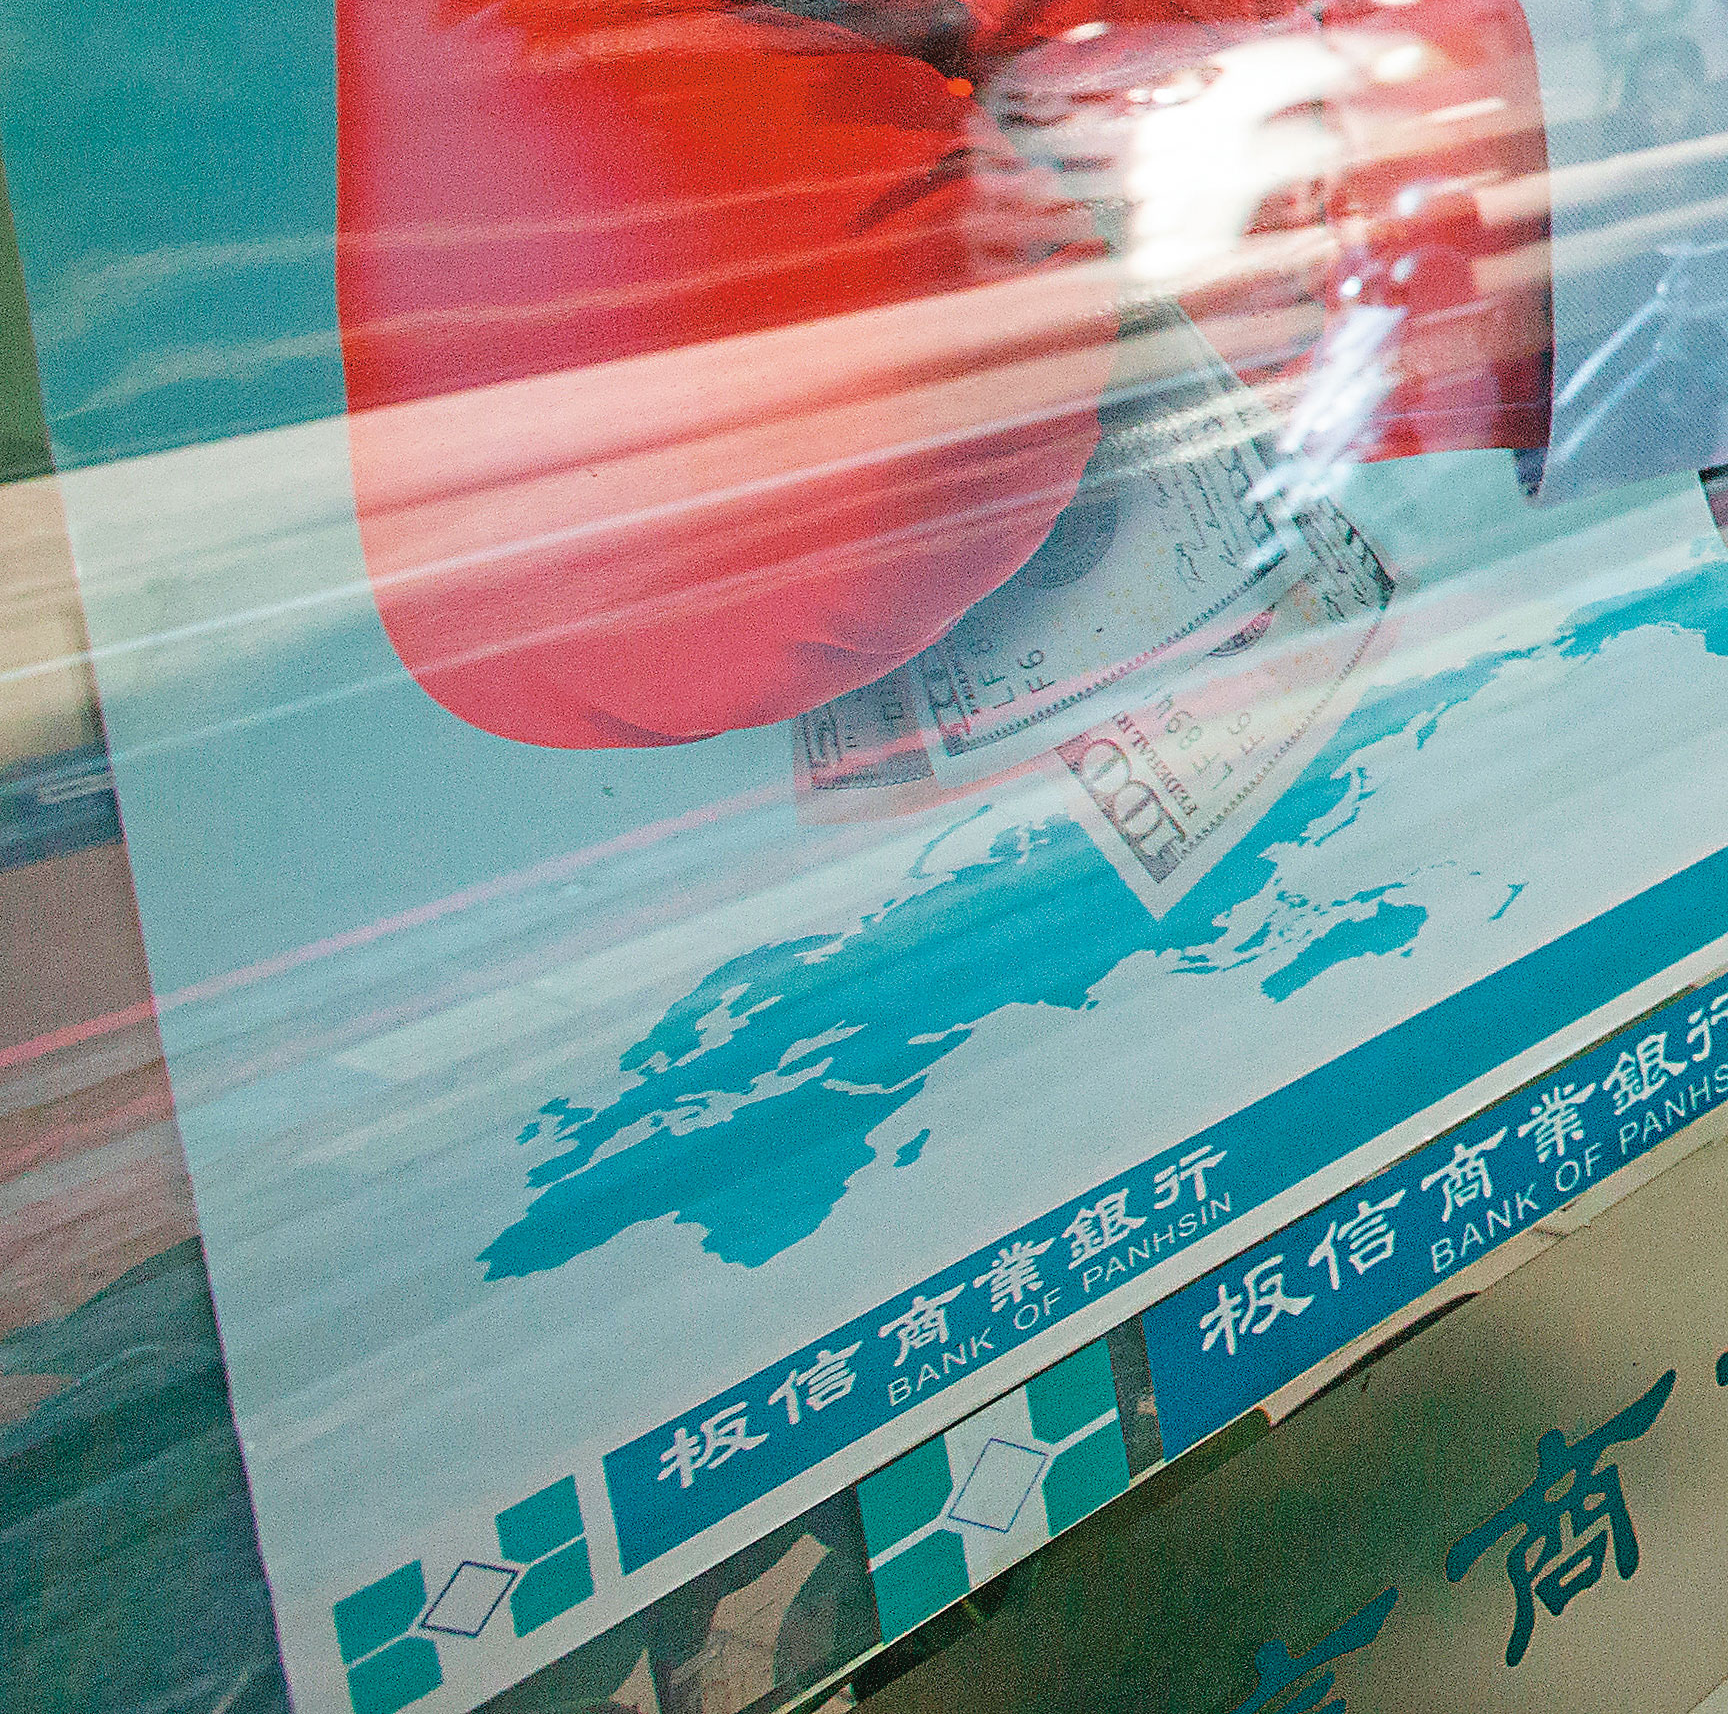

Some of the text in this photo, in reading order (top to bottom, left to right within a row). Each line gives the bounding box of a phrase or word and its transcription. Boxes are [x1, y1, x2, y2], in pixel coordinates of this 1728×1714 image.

[886, 1191, 1232, 1407] BANK OF PANHSIN
[1431, 1183, 1540, 1274] BANK
[1554, 1142, 1604, 1193] OF
[656, 1144, 1229, 1489] 板信商業銀行
